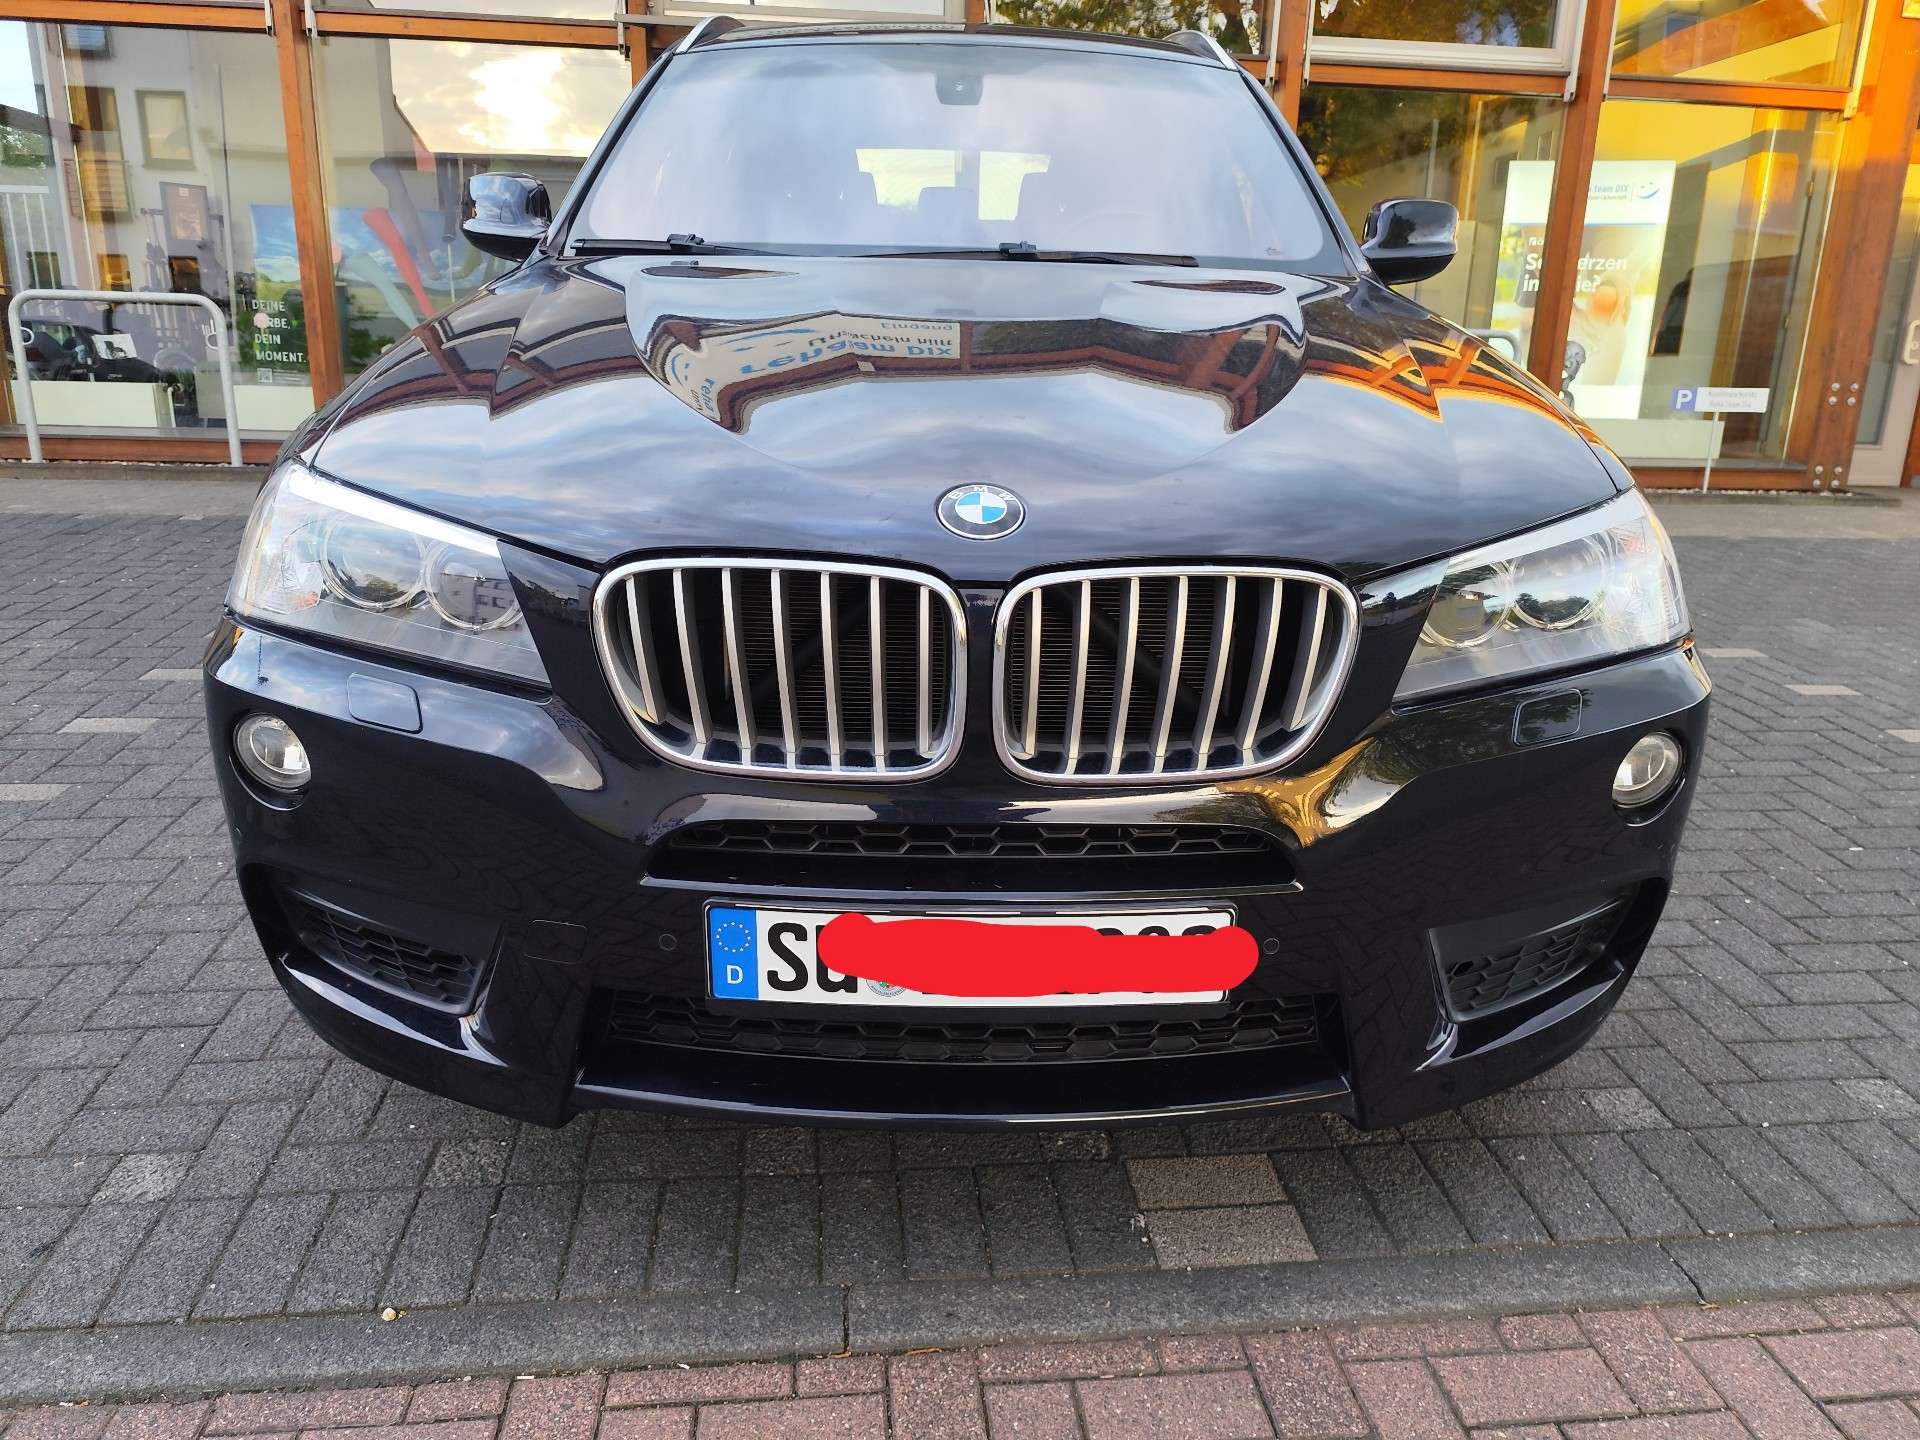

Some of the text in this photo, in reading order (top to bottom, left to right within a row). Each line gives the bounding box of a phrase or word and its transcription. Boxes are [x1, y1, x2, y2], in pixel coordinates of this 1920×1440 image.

[252, 299, 285, 312] DEINE
[262, 317, 291, 330] RBE,
[254, 333, 281, 345] DEIN
[255, 350, 307, 363] MOMENT.
[1675, 389, 1693, 409] P
[947, 486, 1017, 501] BMW
[726, 964, 744, 984] D
